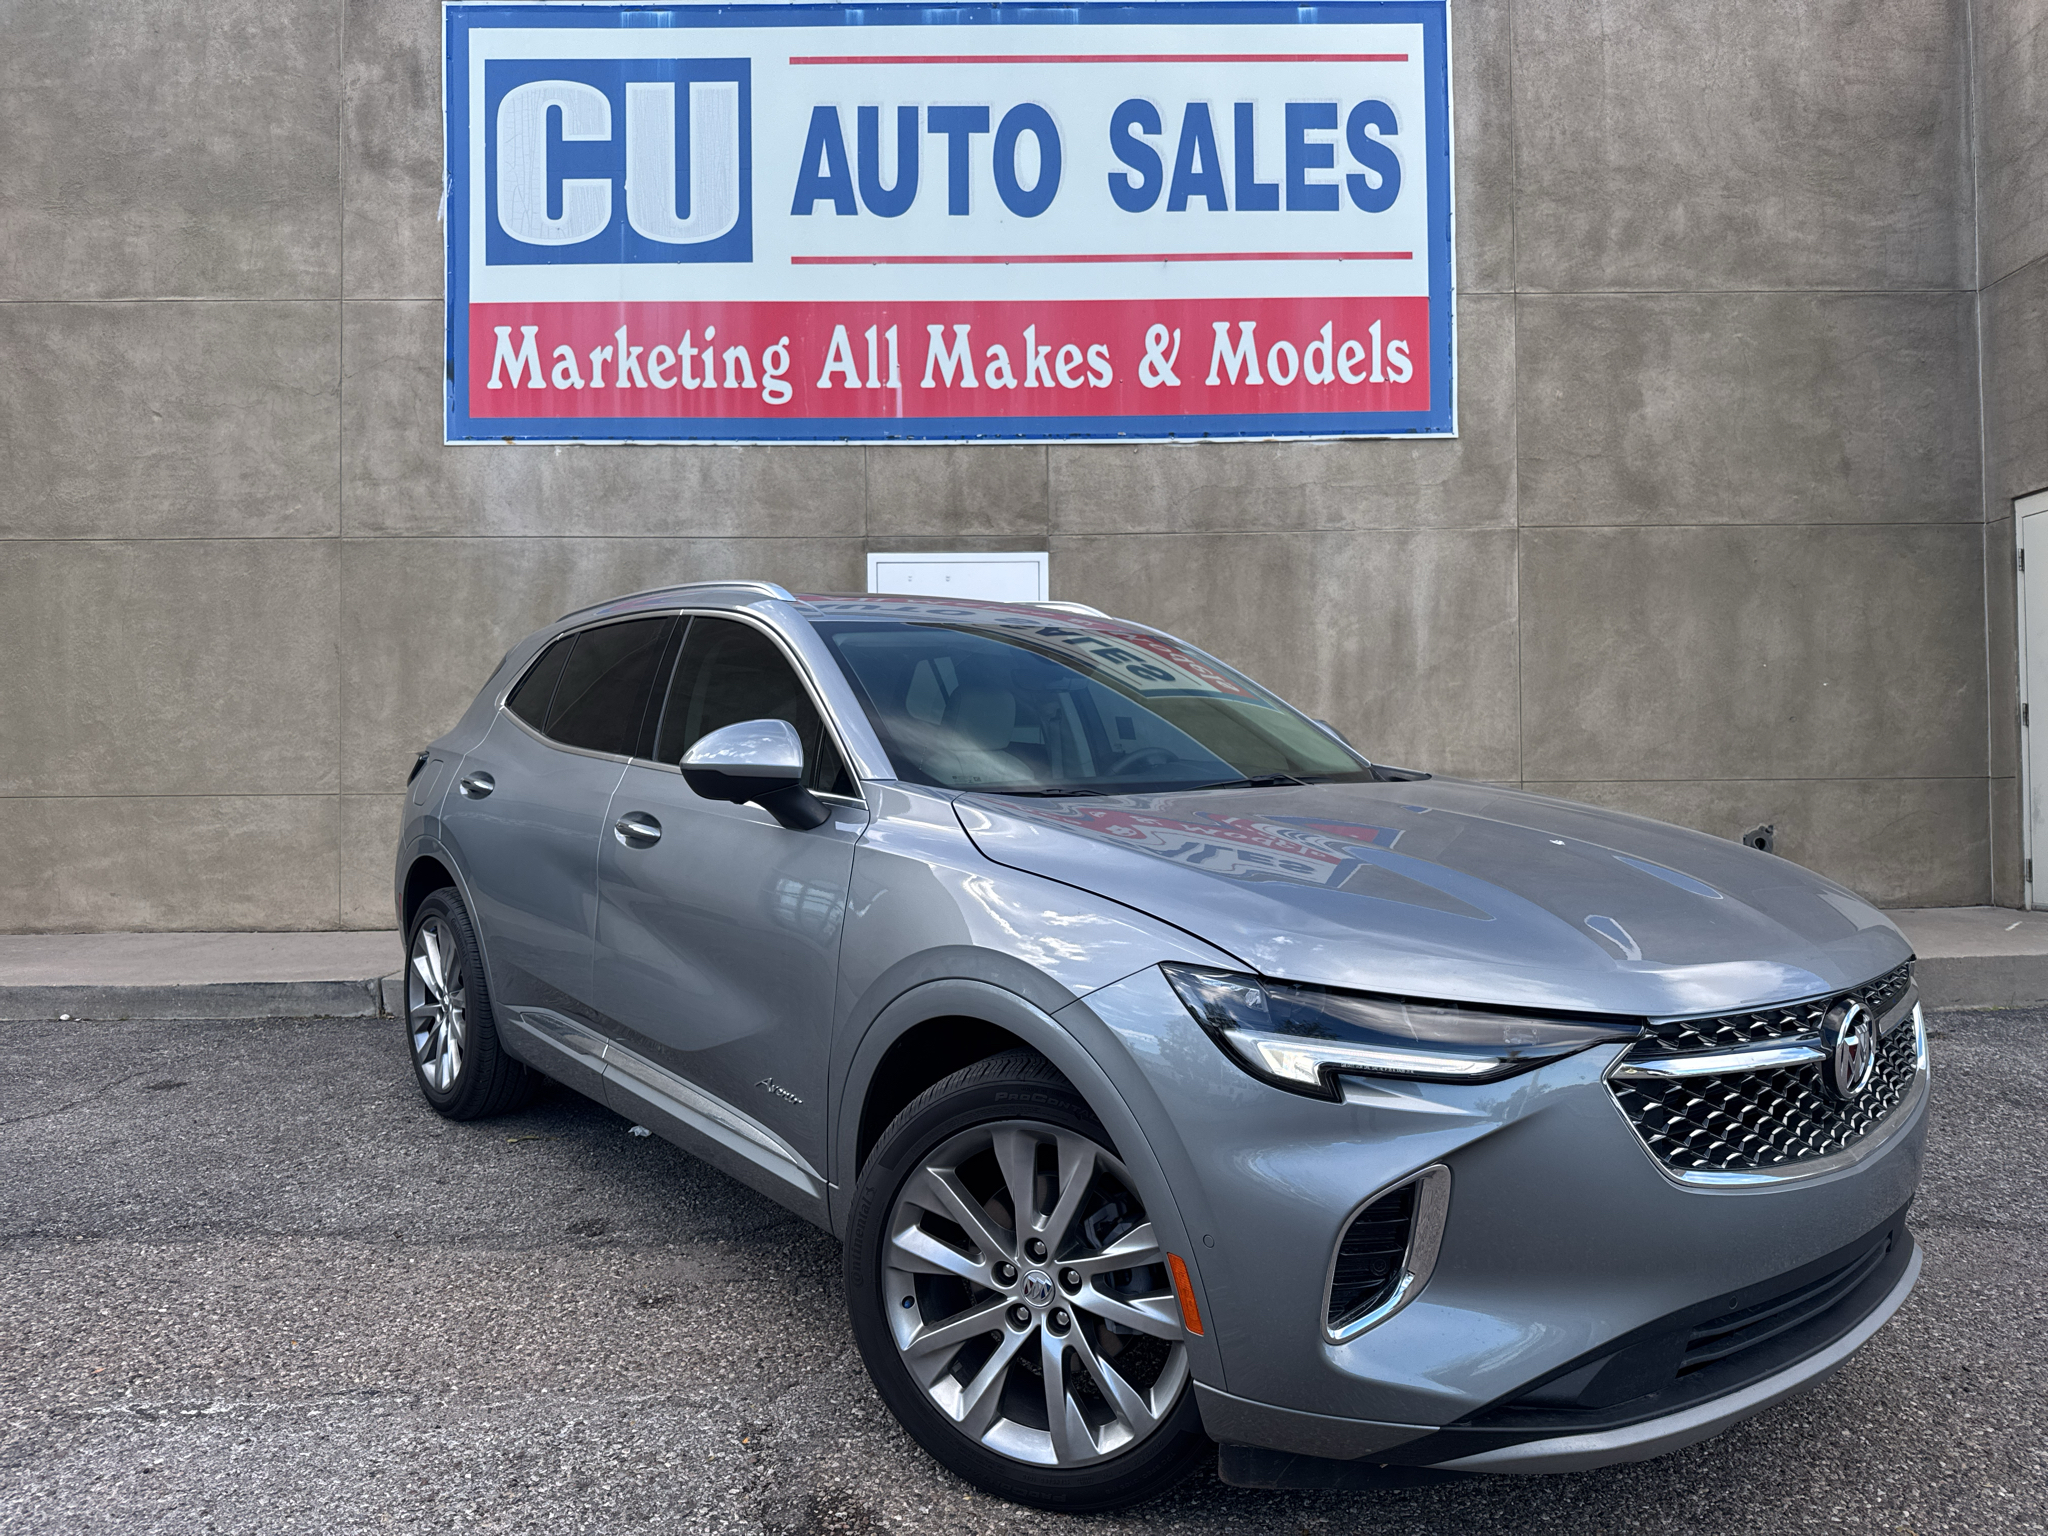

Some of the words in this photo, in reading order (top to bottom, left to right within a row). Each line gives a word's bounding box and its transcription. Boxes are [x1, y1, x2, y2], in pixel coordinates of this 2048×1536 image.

[496, 79, 740, 246] CU
[790, 102, 1062, 219] AUTO
[1107, 98, 1402, 214] SALES
[486, 324, 794, 406] Marketing
[816, 324, 901, 390] All
[920, 323, 1114, 390] Makes
[1137, 323, 1182, 389] &
[1205, 319, 1414, 387] Models
[850, 1196, 873, 1289] Continental
